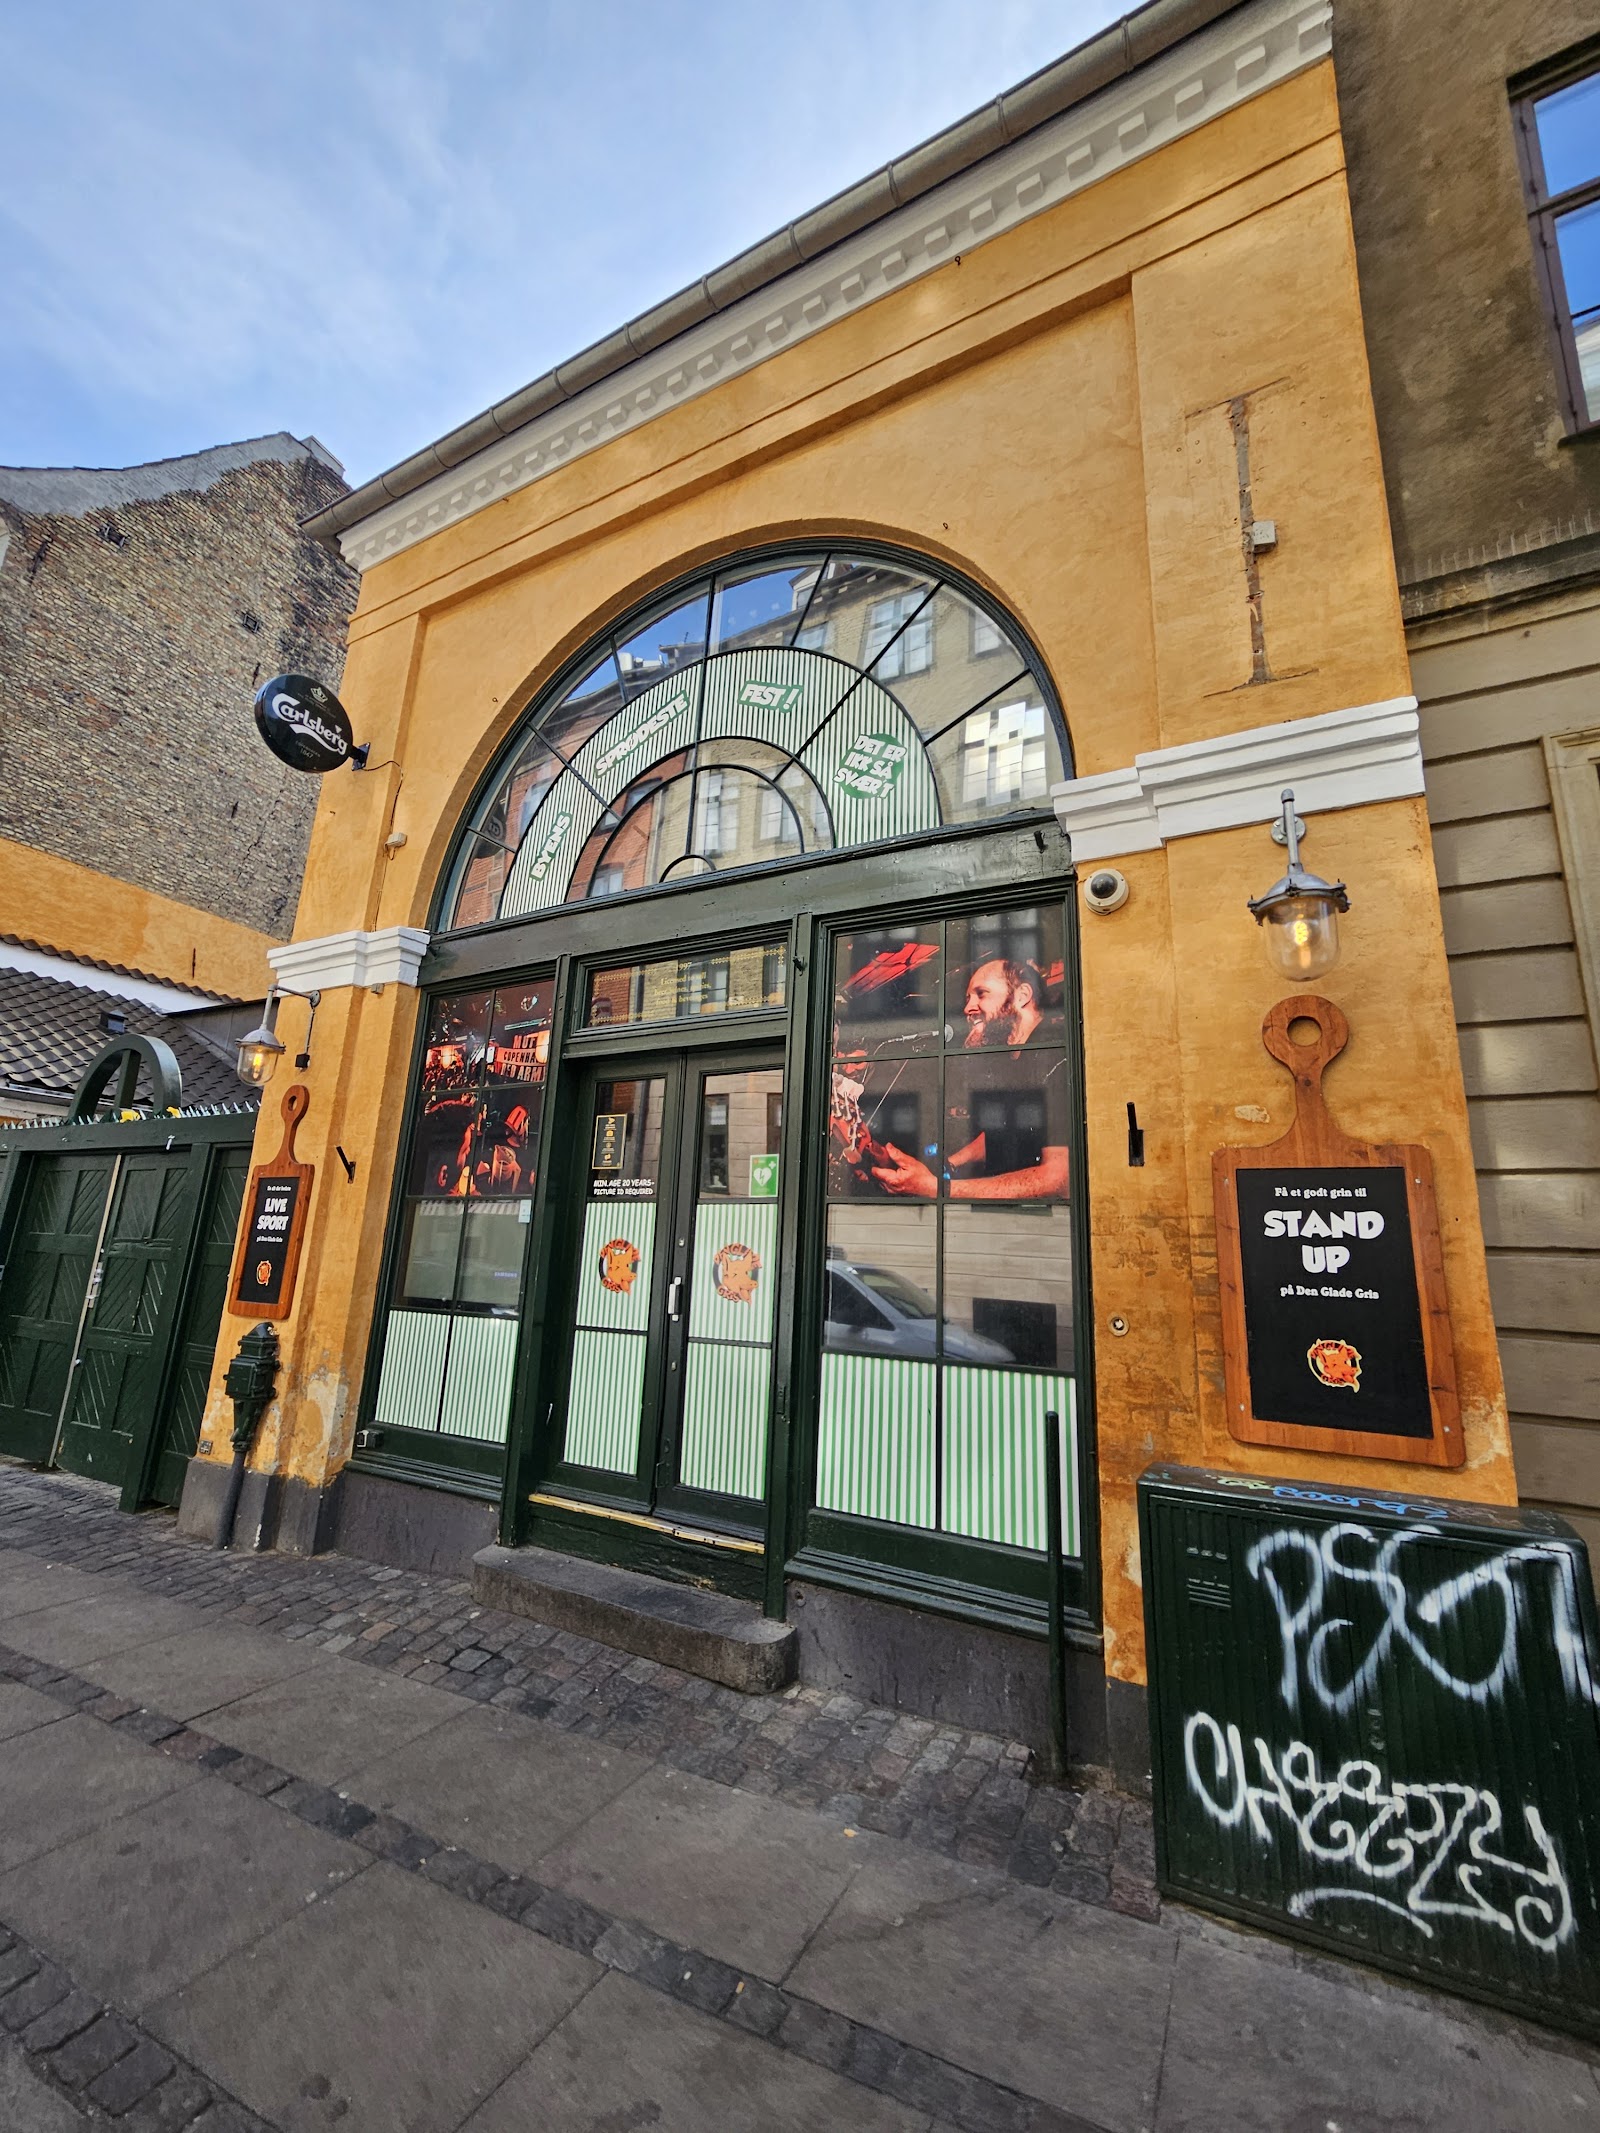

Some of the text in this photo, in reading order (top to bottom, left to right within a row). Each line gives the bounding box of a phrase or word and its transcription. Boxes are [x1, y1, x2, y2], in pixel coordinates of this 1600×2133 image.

[272, 693, 348, 755] Carlsberg
[595, 692, 688, 776] SPRØDESTE
[854, 735, 907, 763] DET ER
[844, 751, 892, 779] IKK SÅ
[531, 814, 572, 878] BYENS
[622, 1179, 631, 1187] 20
[1274, 1186, 1367, 1199] Få et godt grin til
[264, 1198, 288, 1213] LIVE
[256, 1215, 289, 1230] SPORT
[1263, 1209, 1385, 1239] STAND
[1301, 1245, 1350, 1274] UP
[1280, 1284, 1380, 1299] på Den Glade Gris
